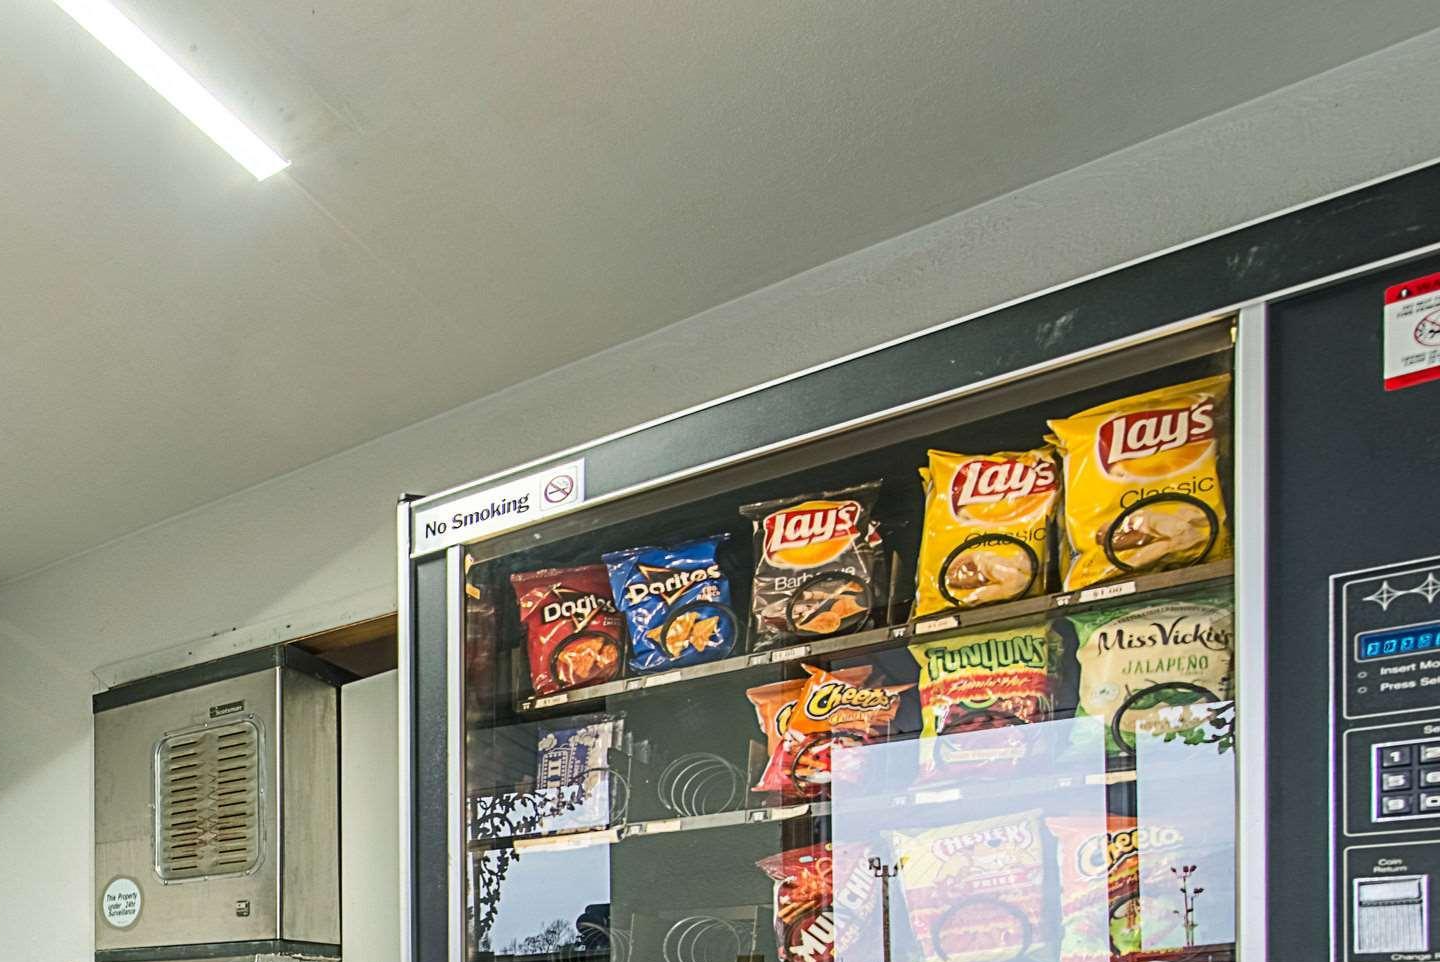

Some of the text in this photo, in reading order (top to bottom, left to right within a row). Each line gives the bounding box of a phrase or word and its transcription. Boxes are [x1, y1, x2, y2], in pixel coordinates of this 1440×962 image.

[1107, 400, 1214, 464] Lay's
[957, 457, 1055, 507] Lay's
[425, 493, 531, 539] No Smoking
[626, 565, 721, 602] Doritos
[1097, 628, 1157, 657] Miss
[1380, 663, 1417, 676] Insert
[1380, 681, 1417, 693] Press
[1390, 953, 1432, 961] Change
